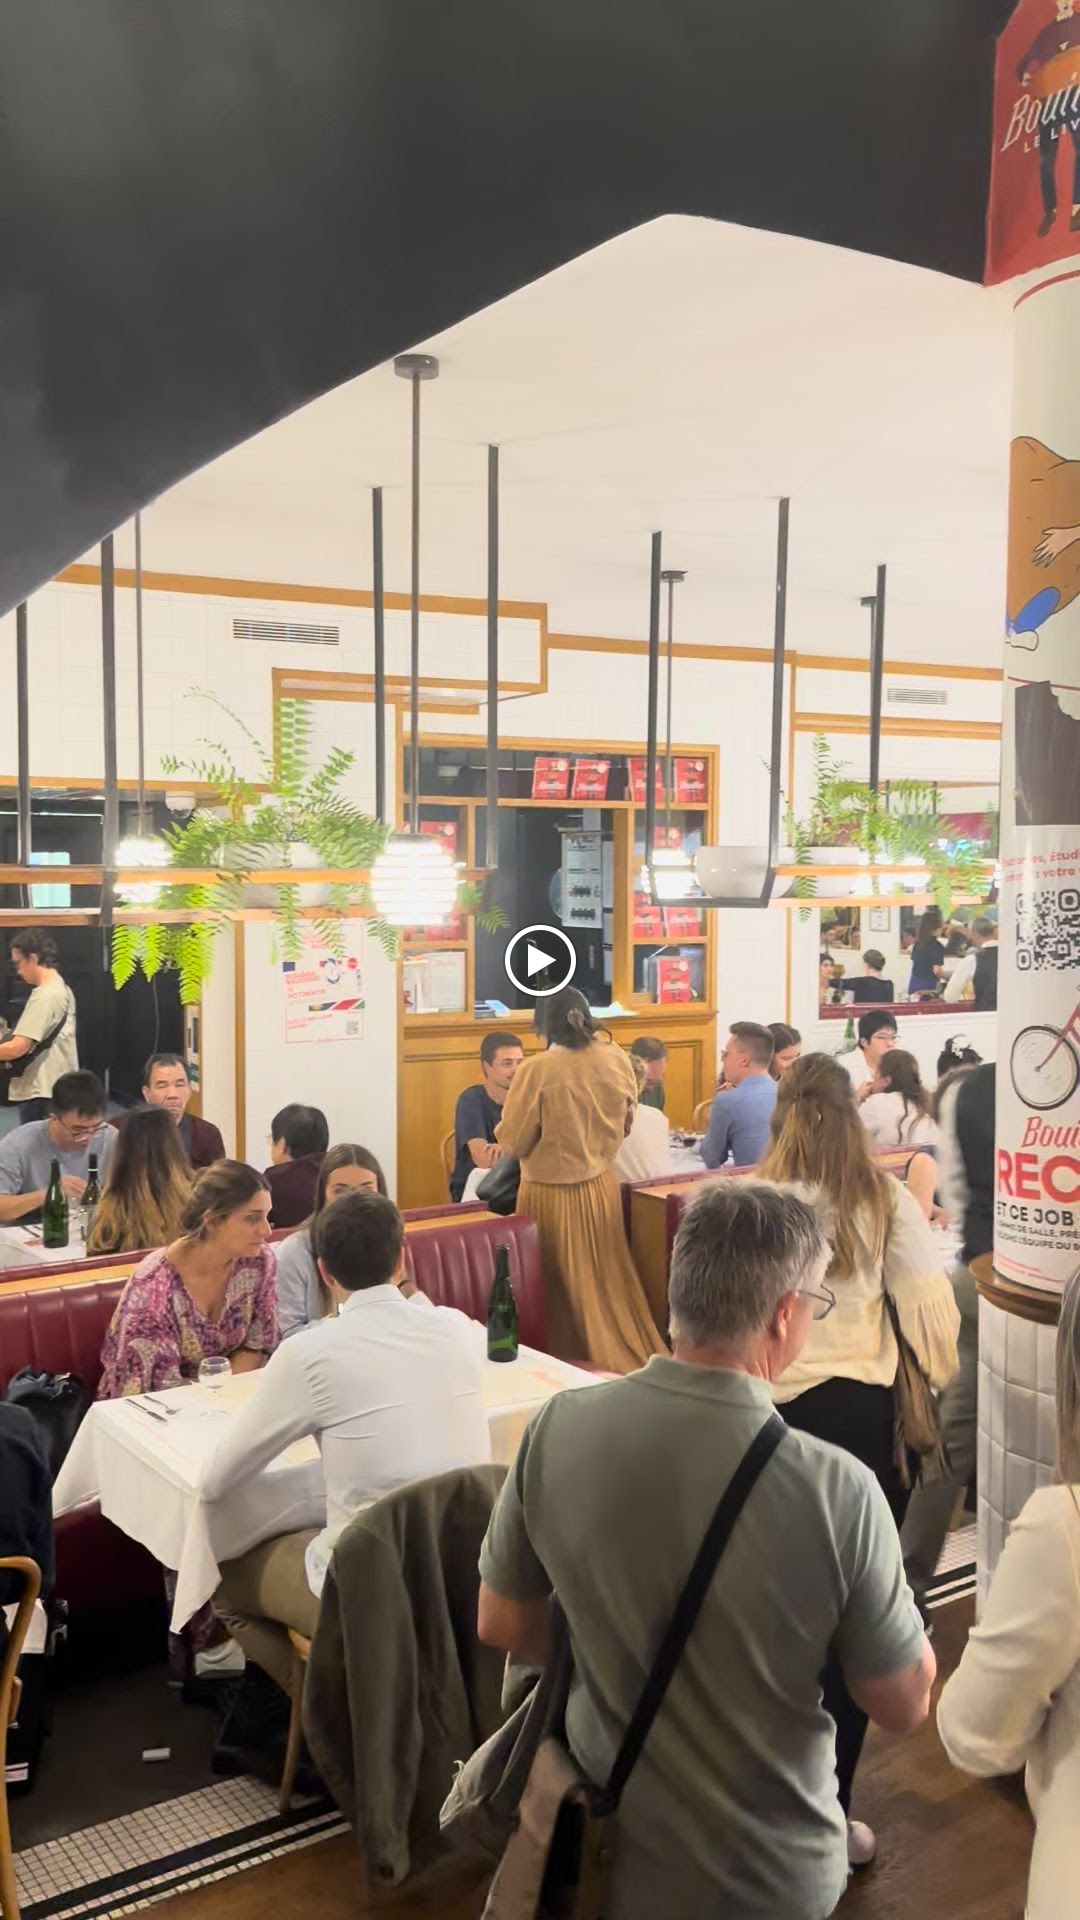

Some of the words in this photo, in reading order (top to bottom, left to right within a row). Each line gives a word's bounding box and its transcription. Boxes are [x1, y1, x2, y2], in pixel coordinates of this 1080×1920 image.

[1023, 126, 1040, 153] LE
[998, 1148, 1080, 1204] REC
[1009, 1204, 1029, 1222] CE
[1033, 1208, 1074, 1226] JOB
